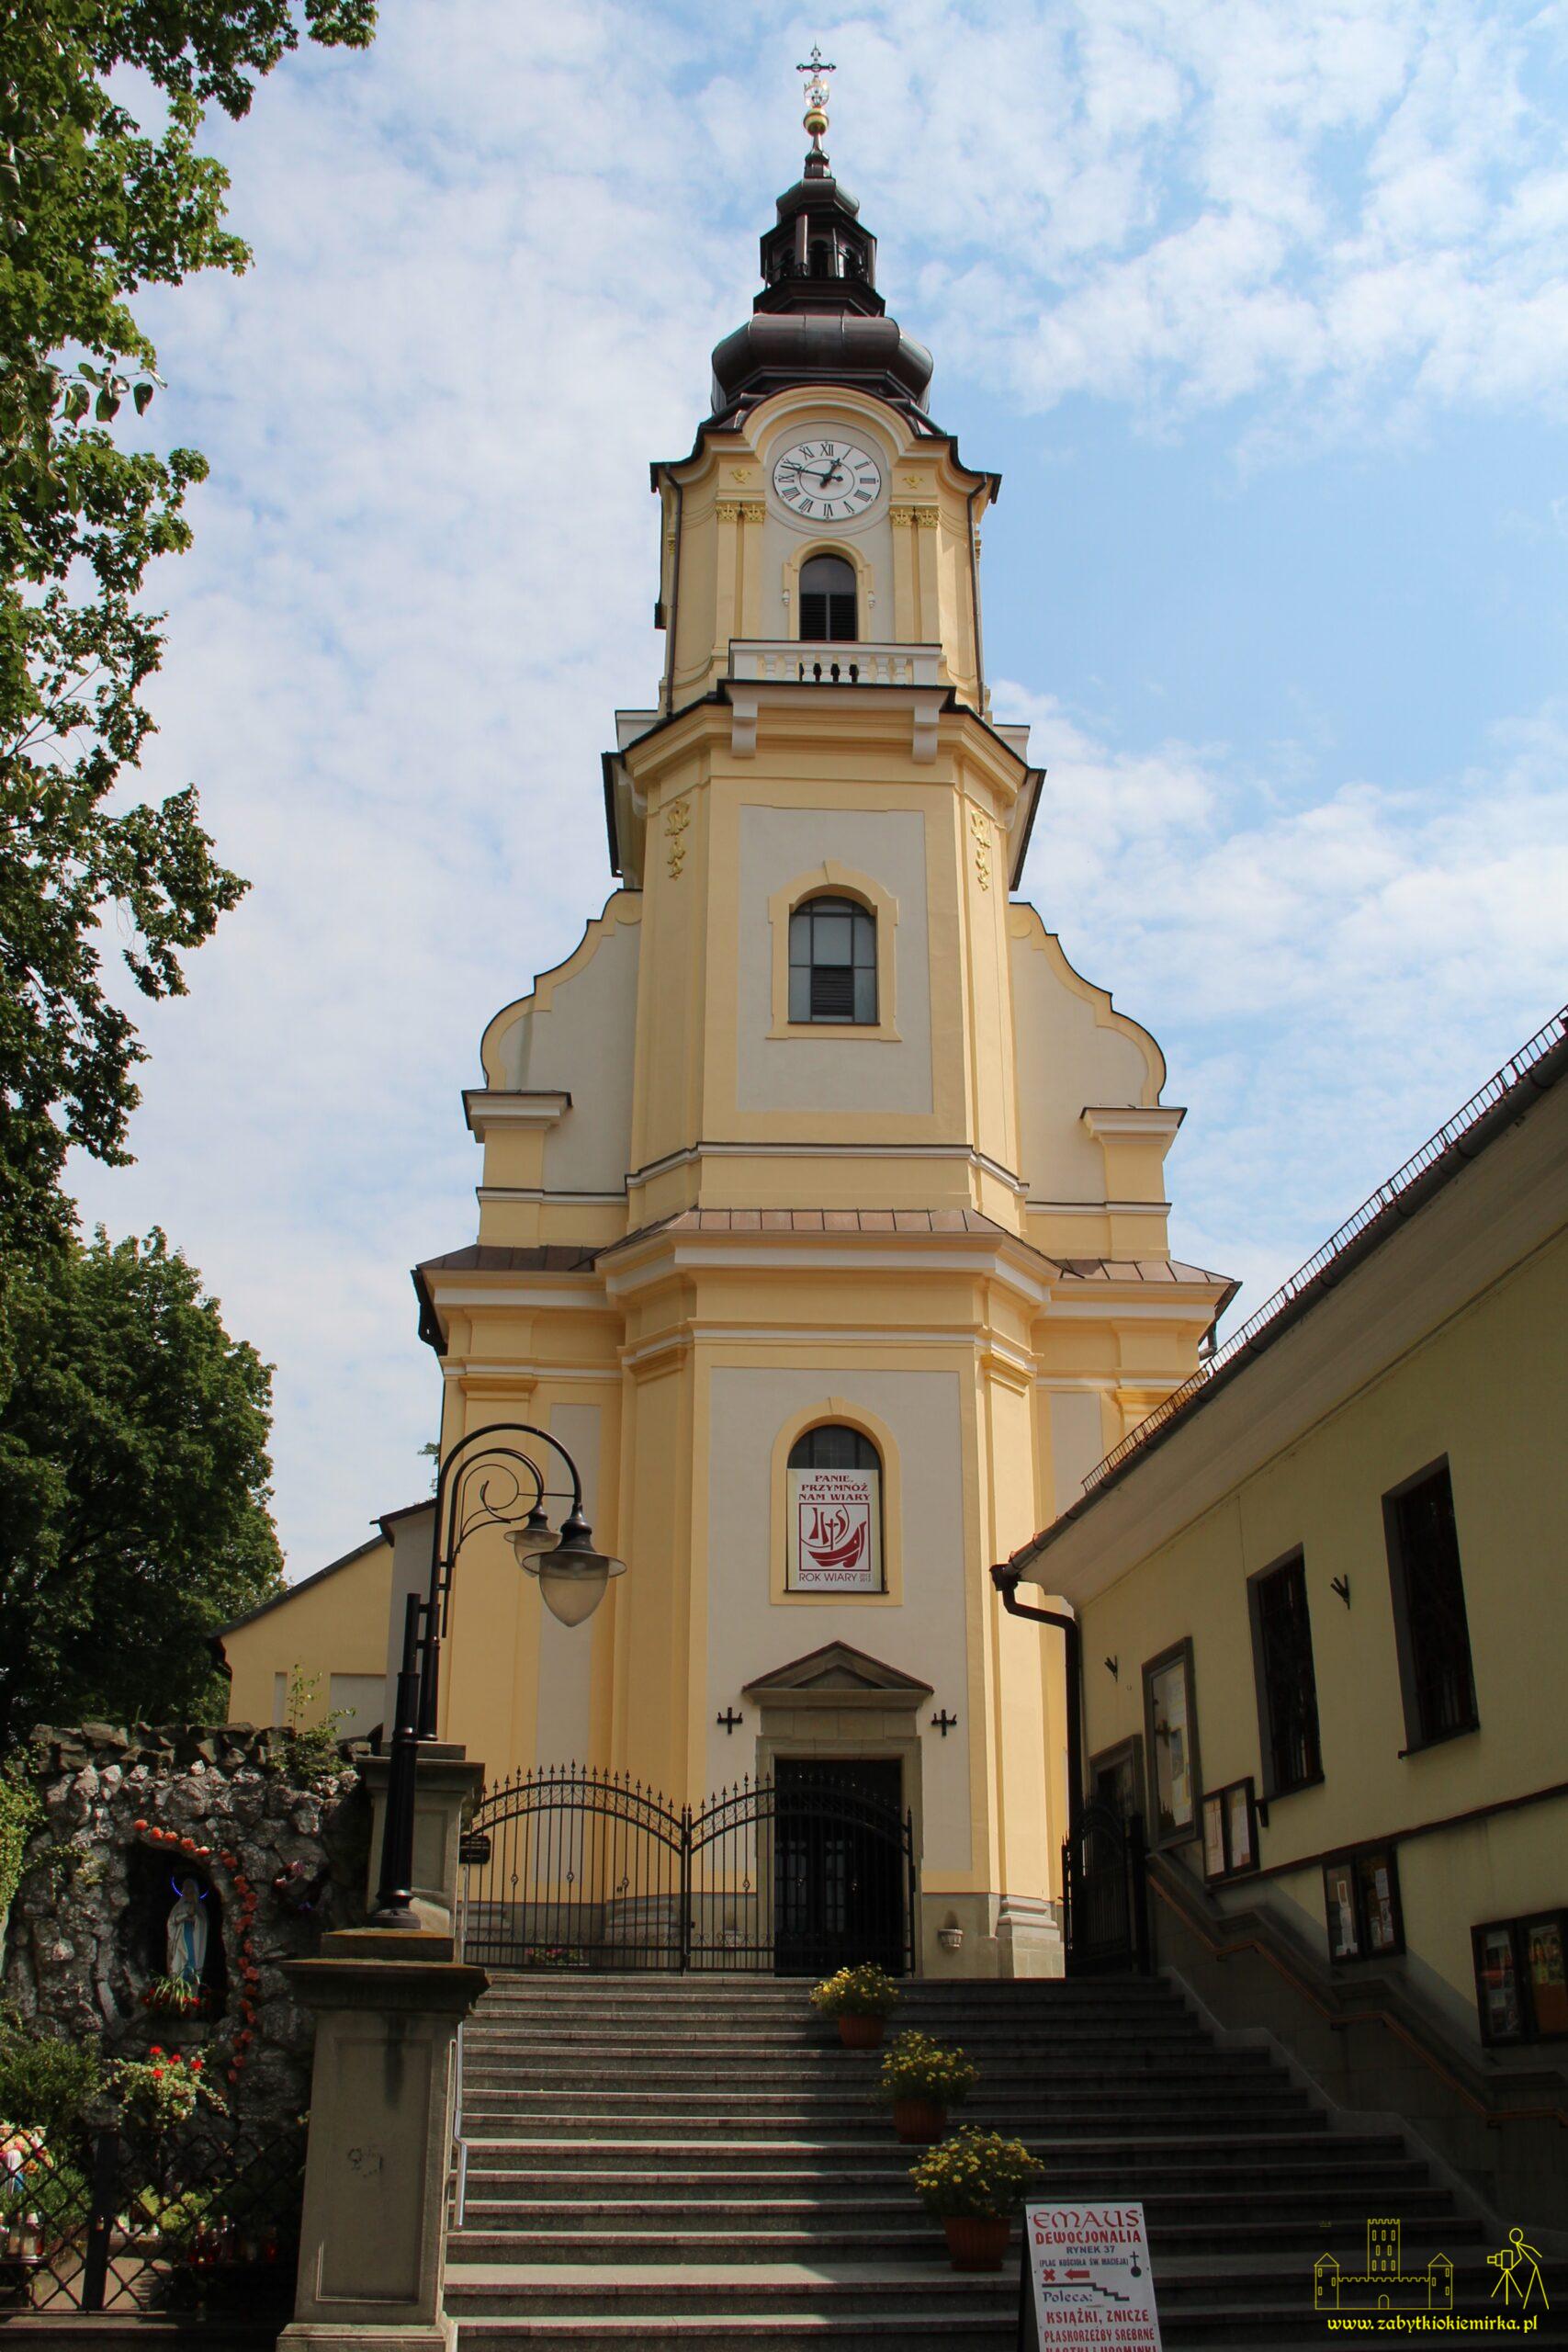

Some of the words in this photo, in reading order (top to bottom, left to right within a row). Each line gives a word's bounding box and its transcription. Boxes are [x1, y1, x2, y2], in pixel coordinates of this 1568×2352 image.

[799, 1572, 821, 1582] ROK
[824, 1572, 857, 1582] WIARY
[1032, 2210, 1140, 2230] EMAUS
[1035, 2230, 1142, 2245] DEWOCJONALIA
[1066, 2245, 1100, 2255] RYNEK
[1103, 2245, 1115, 2254] 37
[1043, 2290, 1093, 2302] Poleca:
[1046, 2308, 1102, 2325] KSIĄŻKI,
[1106, 2309, 1149, 2323] ZNICZE
[1114, 2327, 1155, 2341] SREBRNE
